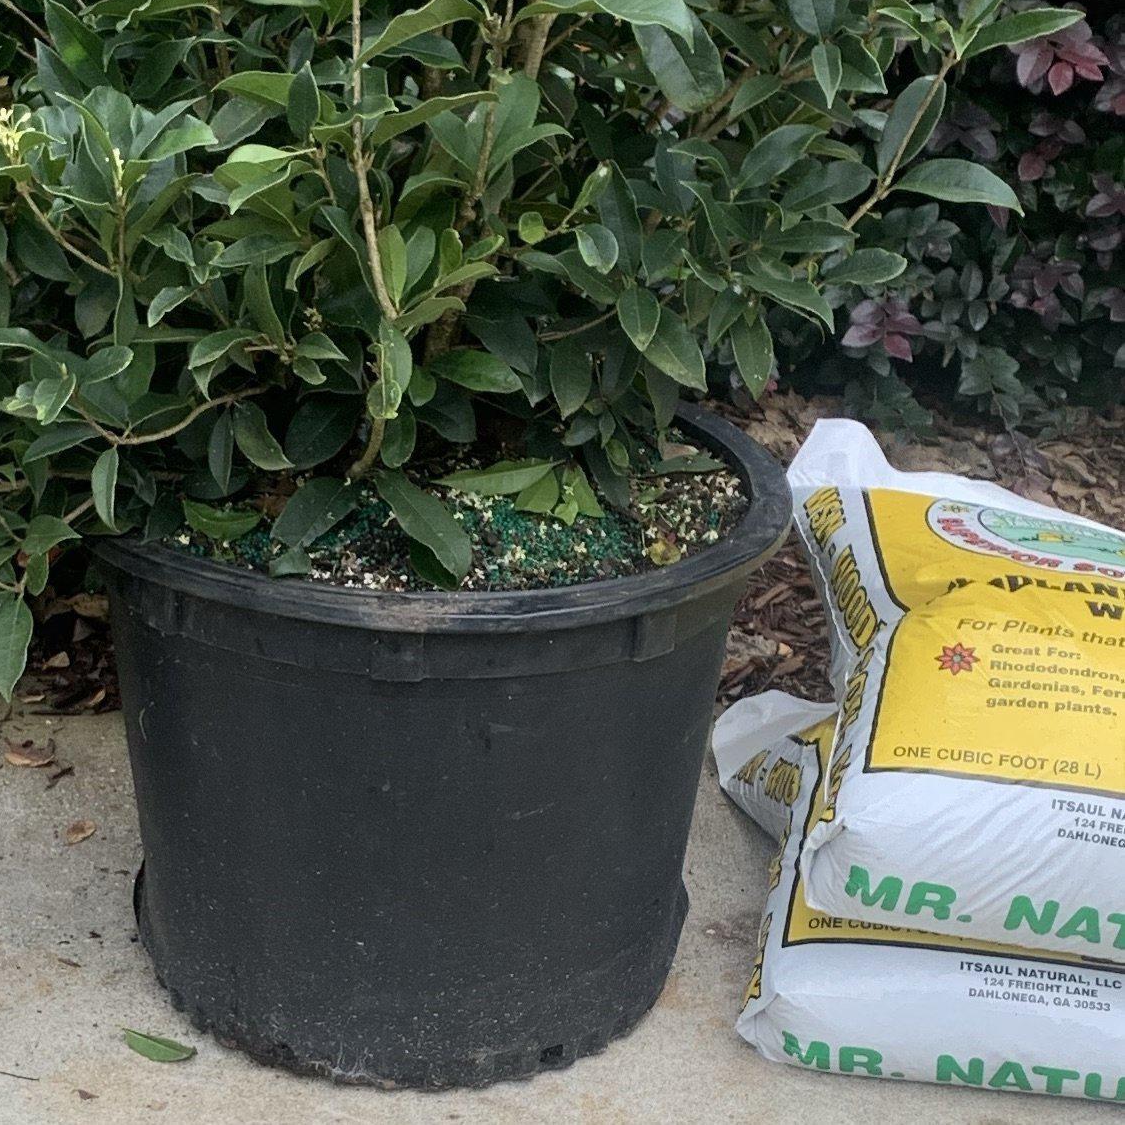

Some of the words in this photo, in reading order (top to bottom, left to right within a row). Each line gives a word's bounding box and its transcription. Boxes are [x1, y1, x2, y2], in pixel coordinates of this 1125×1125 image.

[956, 618, 997, 631] For
[1003, 620, 1074, 638] Plants
[1081, 631, 1125, 648] that
[992, 643, 1041, 656] Great
[1047, 646, 1082, 659] For:
[990, 660, 1125, 684] Rhododendron,
[988, 677, 1086, 696] Gardenias,
[986, 697, 1049, 708] garden
[1055, 700, 1117, 716] plants.
[893, 746, 931, 759] ONE
[937, 748, 993, 765] CUBIC
[999, 754, 1049, 770] FOOT
[1053, 760, 1079, 775] (28
[1085, 762, 1102, 779] L)
[1051, 799, 1106, 816] ITSAUL
[1075, 817, 1095, 829] 124
[1099, 821, 1125, 835] FRE
[844, 864, 972, 923] MR.
[808, 917, 843, 929] ONE
[959, 961, 1013, 976] ITSAUL
[1017, 967, 1091, 986] NATURAL,
[1095, 977, 1123, 989] LLC
[983, 977, 1004, 987] 124
[1008, 979, 1062, 993] FREIGHT
[1066, 986, 1099, 998] LANE
[968, 988, 1049, 1006] DAHLONEGA,
[1053, 997, 1071, 1007] GA
[1074, 1000, 1111, 1012] 30533
[782, 1030, 905, 1078] MR.
[936, 1054, 1125, 1101] NATU
